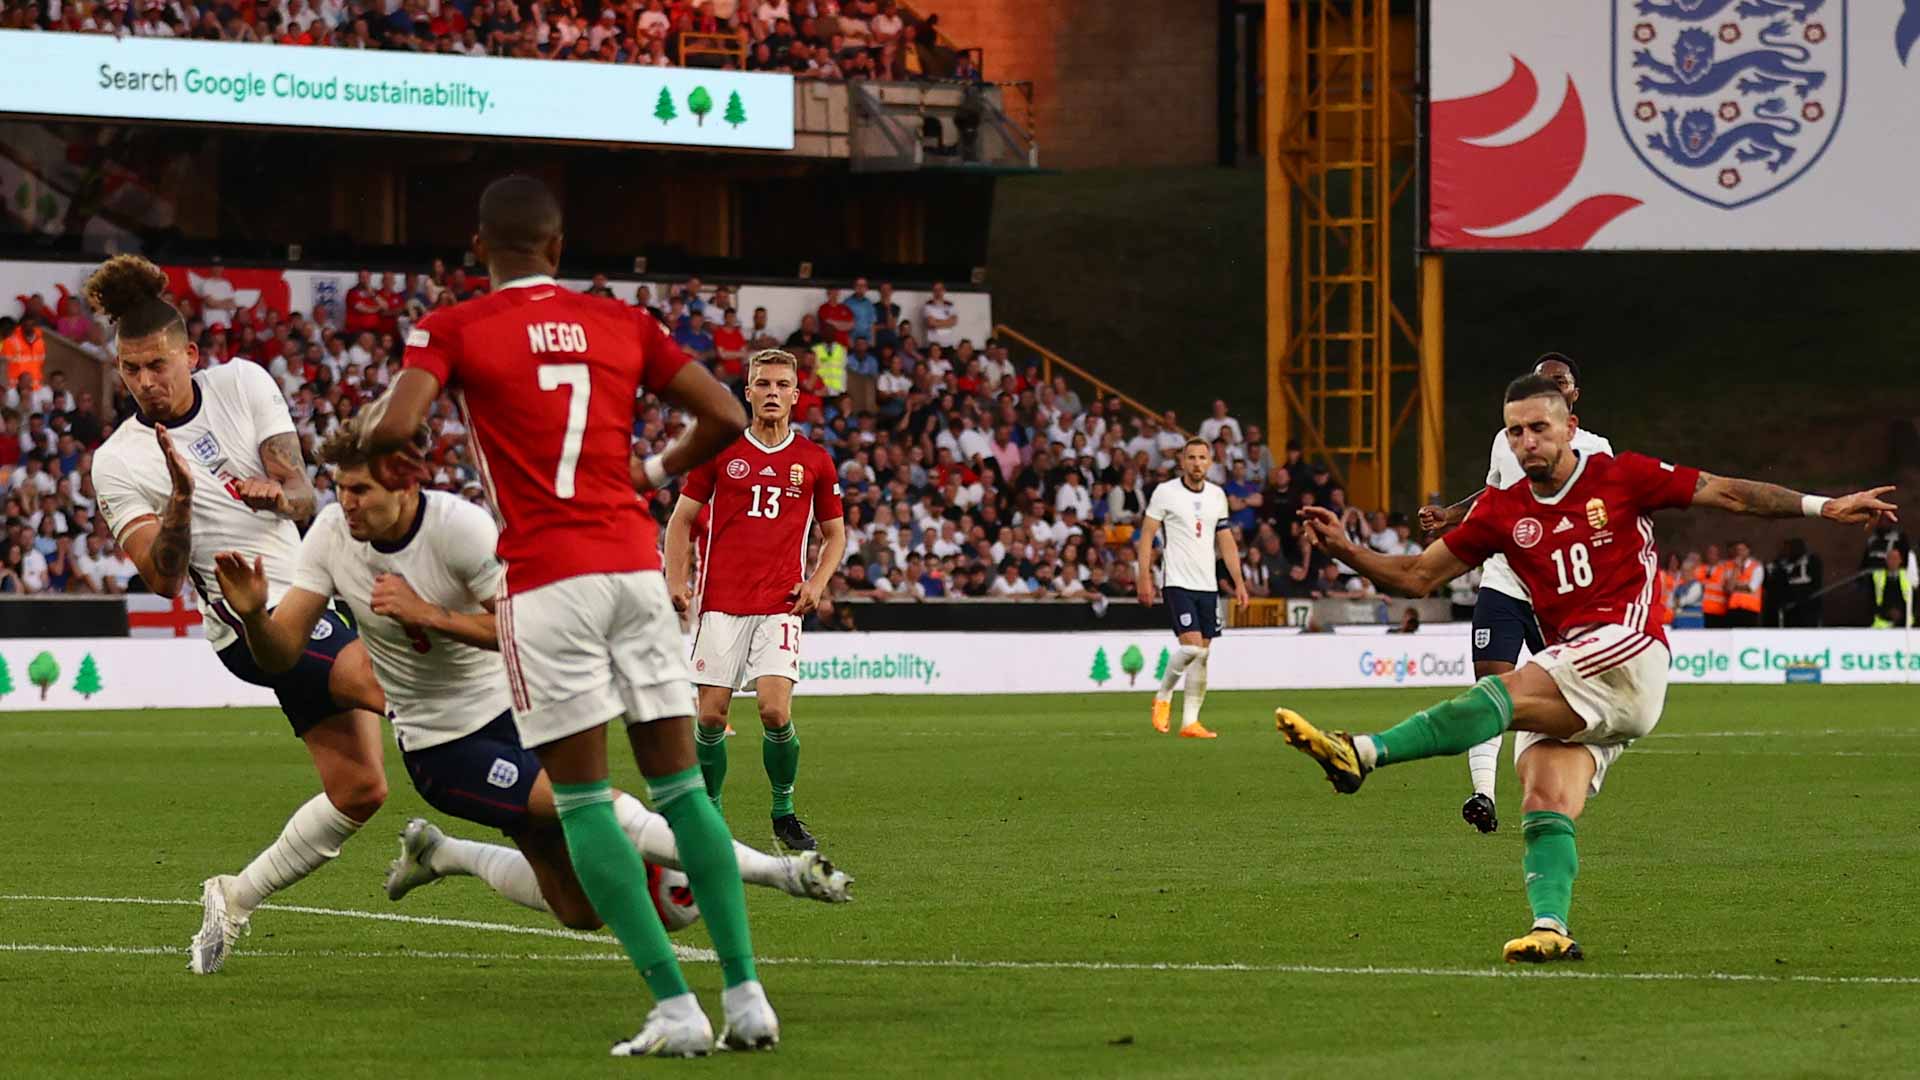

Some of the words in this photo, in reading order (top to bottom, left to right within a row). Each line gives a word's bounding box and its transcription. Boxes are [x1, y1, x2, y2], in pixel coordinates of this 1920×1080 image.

[99, 64, 178, 92] Search
[184, 68, 266, 102] Google
[272, 73, 337, 100] Cloud
[343, 80, 495, 114] sustainability.
[527, 322, 587, 353] NEGO
[538, 363, 591, 498] 7
[747, 484, 781, 519] 13
[1195, 519, 1203, 538] 9
[1551, 542, 1593, 595] 18
[799, 654, 941, 685] sustainability.
[1360, 651, 1416, 682] Google
[1421, 653, 1465, 676] Cloud
[1674, 649, 1729, 677] ogle
